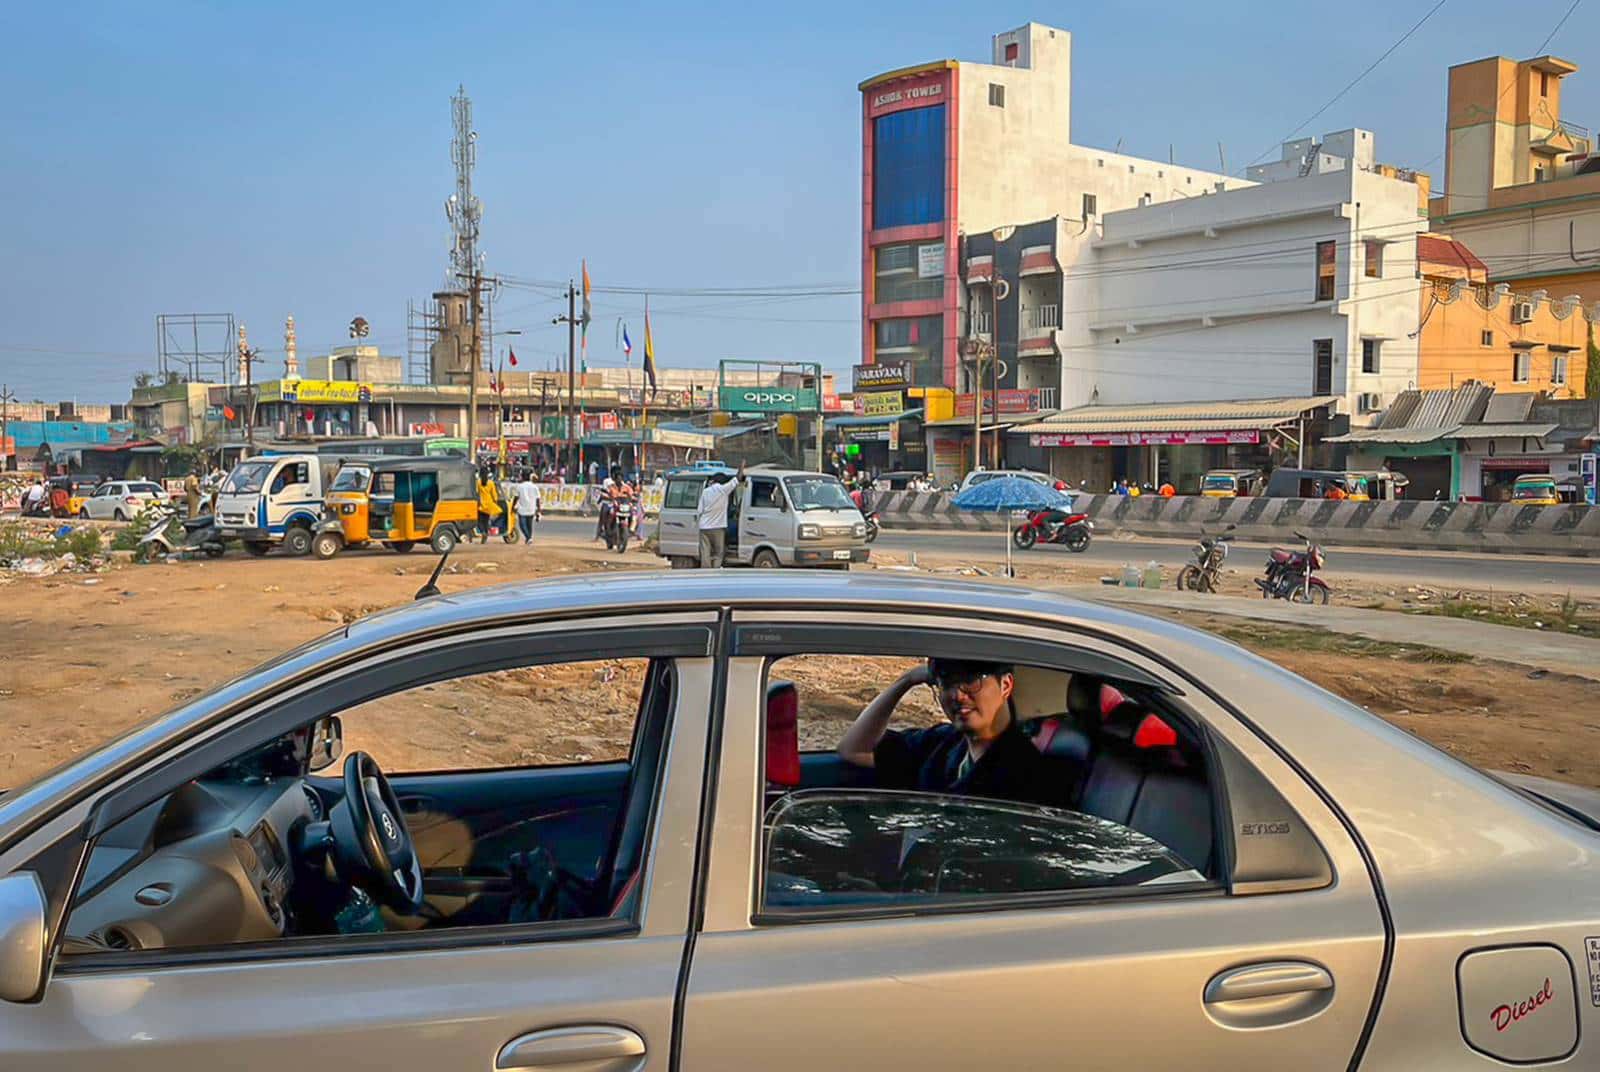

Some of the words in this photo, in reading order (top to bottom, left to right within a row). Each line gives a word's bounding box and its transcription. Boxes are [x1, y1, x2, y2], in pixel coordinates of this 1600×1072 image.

[905, 83, 943, 98] TOWER
[1241, 823, 1290, 835] ETIOS
[1490, 977, 1553, 1031] Diesel
